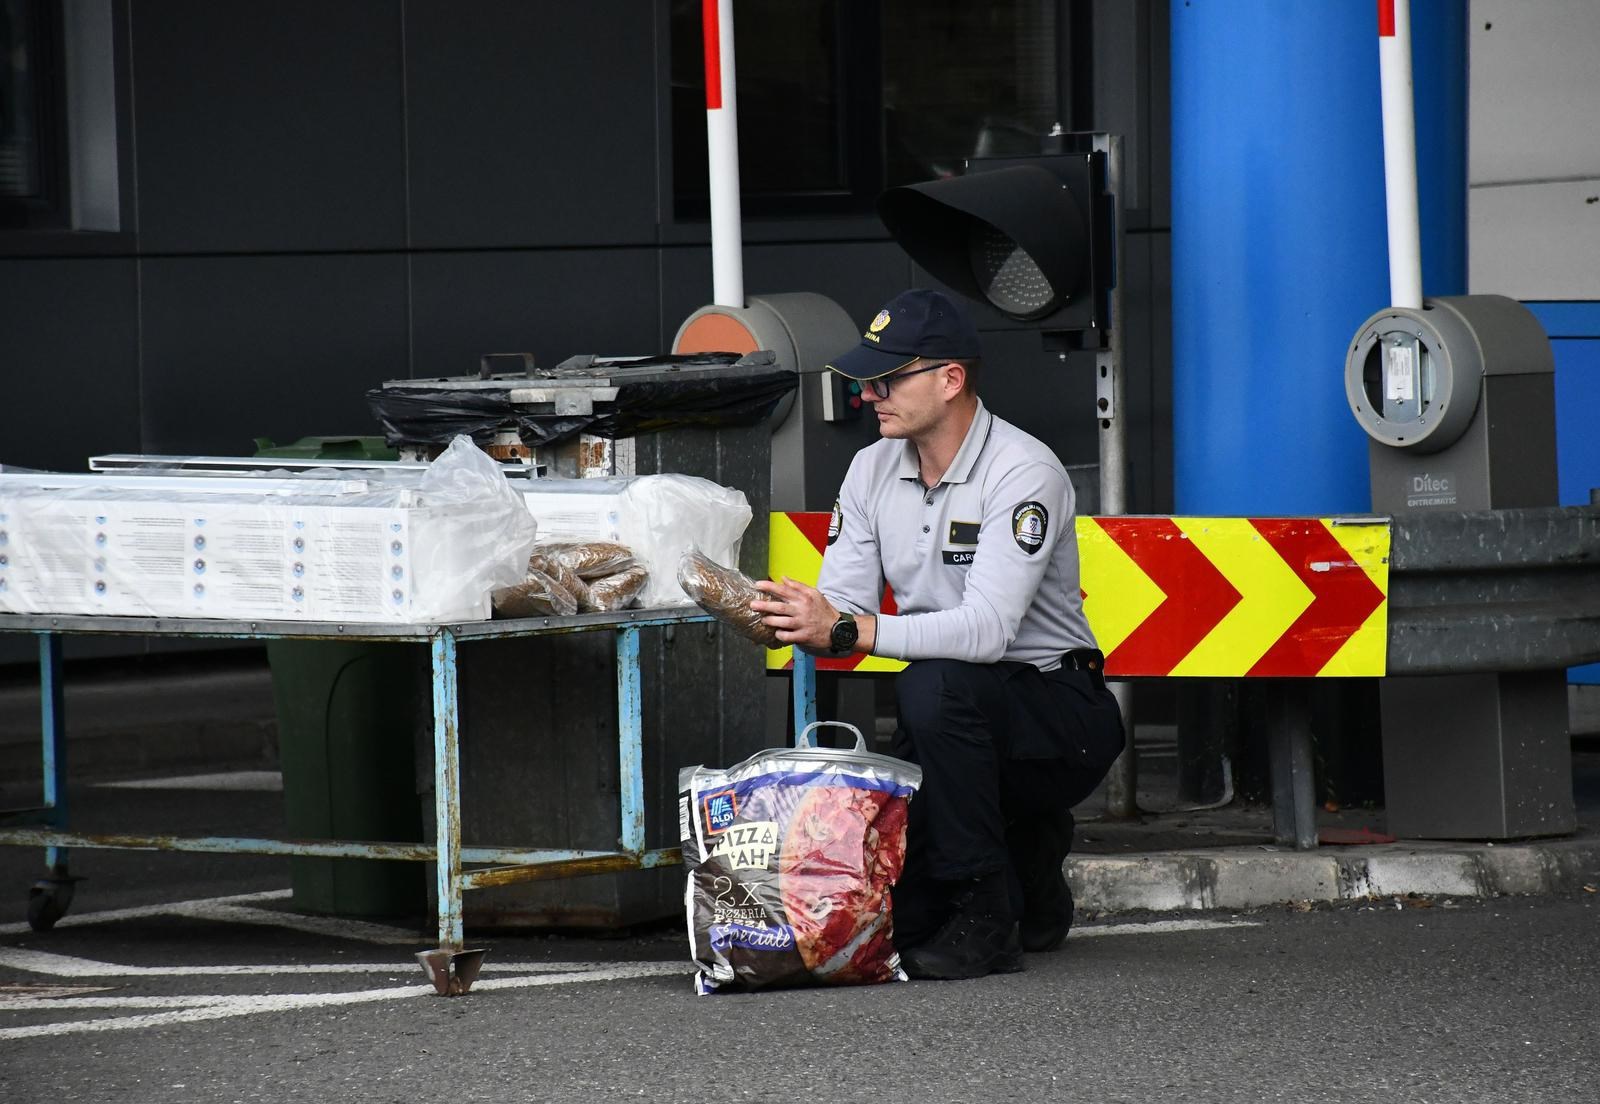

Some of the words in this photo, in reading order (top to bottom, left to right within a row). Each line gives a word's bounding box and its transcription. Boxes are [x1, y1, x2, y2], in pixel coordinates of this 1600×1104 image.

[712, 812, 734, 824] ALDI
[716, 827, 774, 851] PIZZA
[714, 907, 768, 919] PIZZERIA
